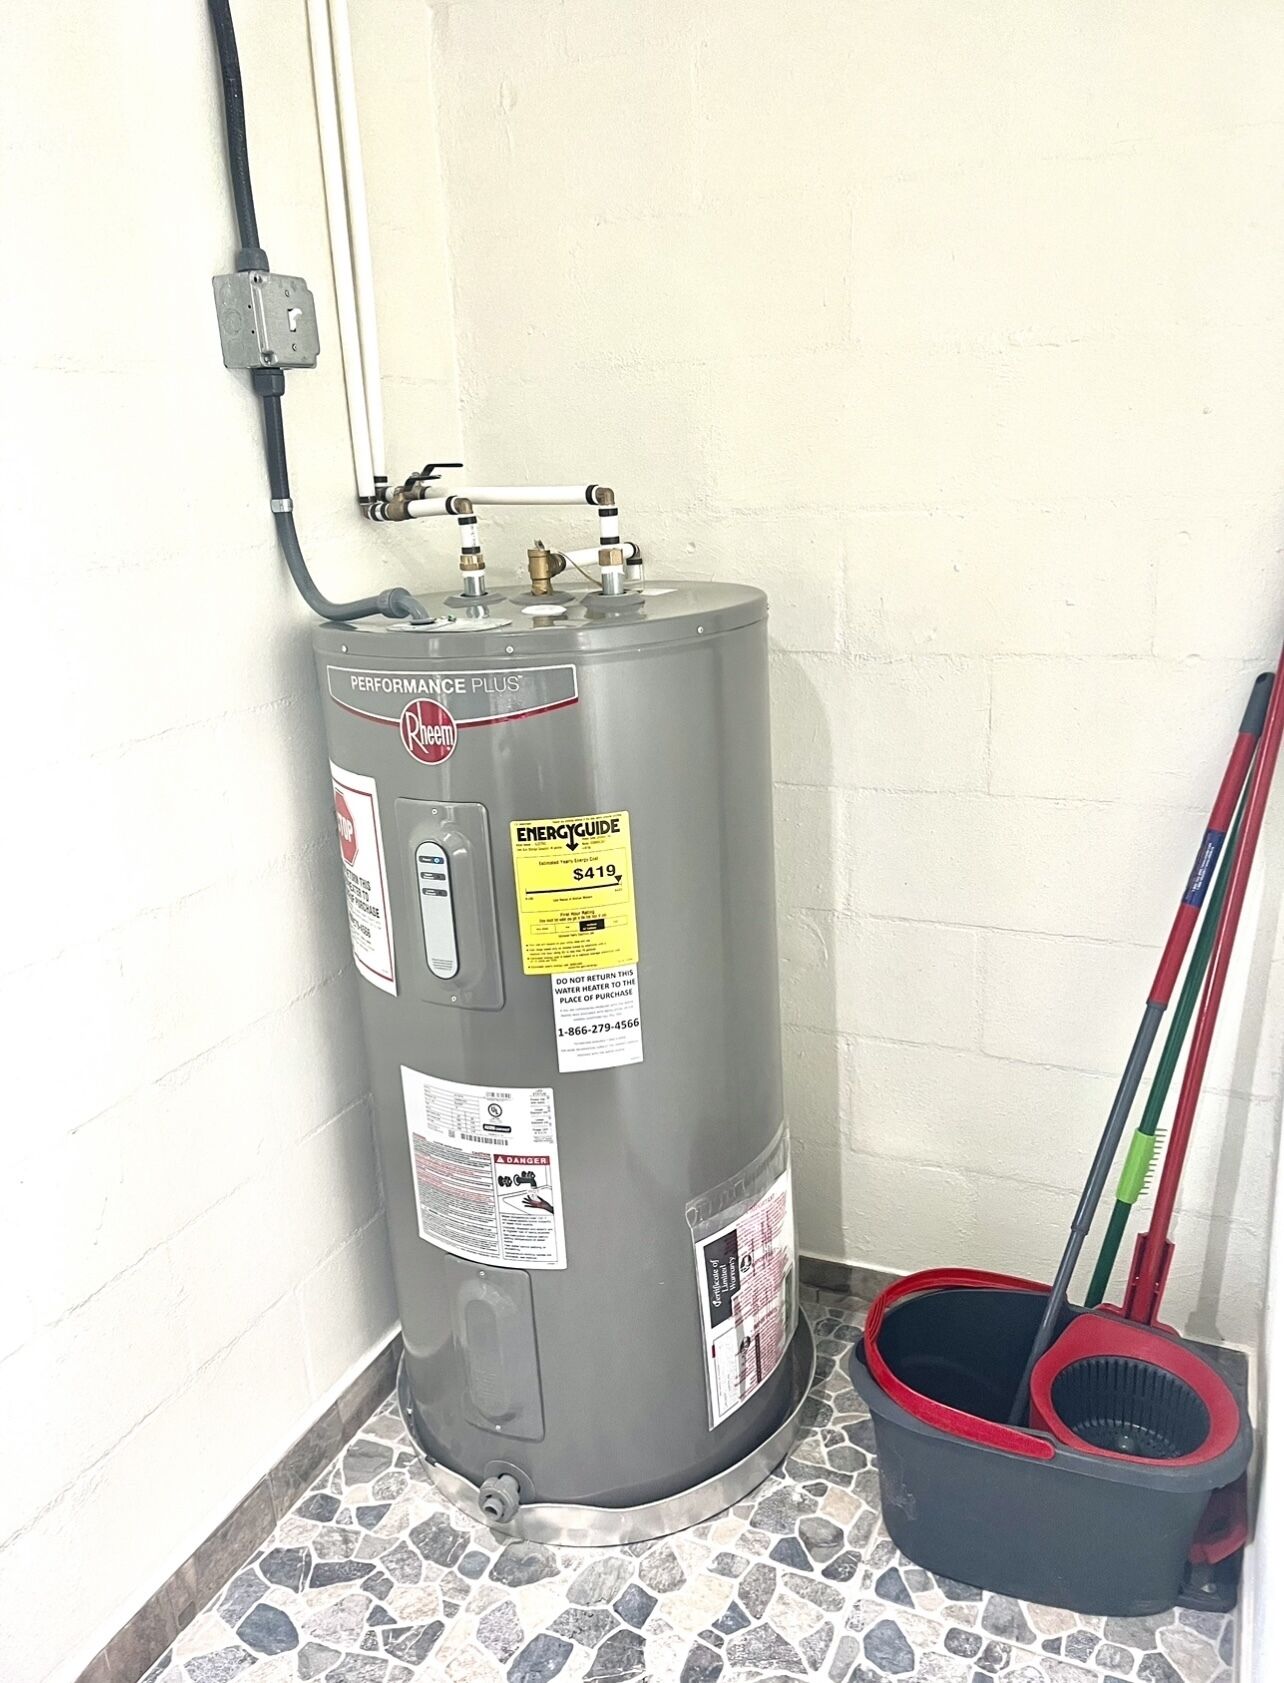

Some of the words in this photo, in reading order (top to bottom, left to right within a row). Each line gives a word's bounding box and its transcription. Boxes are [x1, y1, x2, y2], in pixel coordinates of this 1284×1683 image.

[350, 675, 466, 694] PERFORMANCE
[471, 676, 520, 694] PLUS
[405, 701, 454, 754] Rheem
[516, 818, 621, 842] ENERGYGUIDE
[573, 864, 616, 881] $419
[555, 977, 568, 985] DO
[569, 976, 586, 984] NOT
[586, 972, 617, 982] RETURN
[617, 969, 634, 977] THIS
[554, 986, 581, 995] WATER
[582, 982, 611, 992] HEATER
[611, 980, 621, 988] TO
[622, 978, 636, 986] THE
[559, 995, 582, 1004] PLACE
[583, 994, 594, 1002] OF
[595, 988, 633, 1001] PURCHASE
[557, 1017, 640, 1037] 1-866-279-4566
[506, 1156, 547, 1164] DANGER
